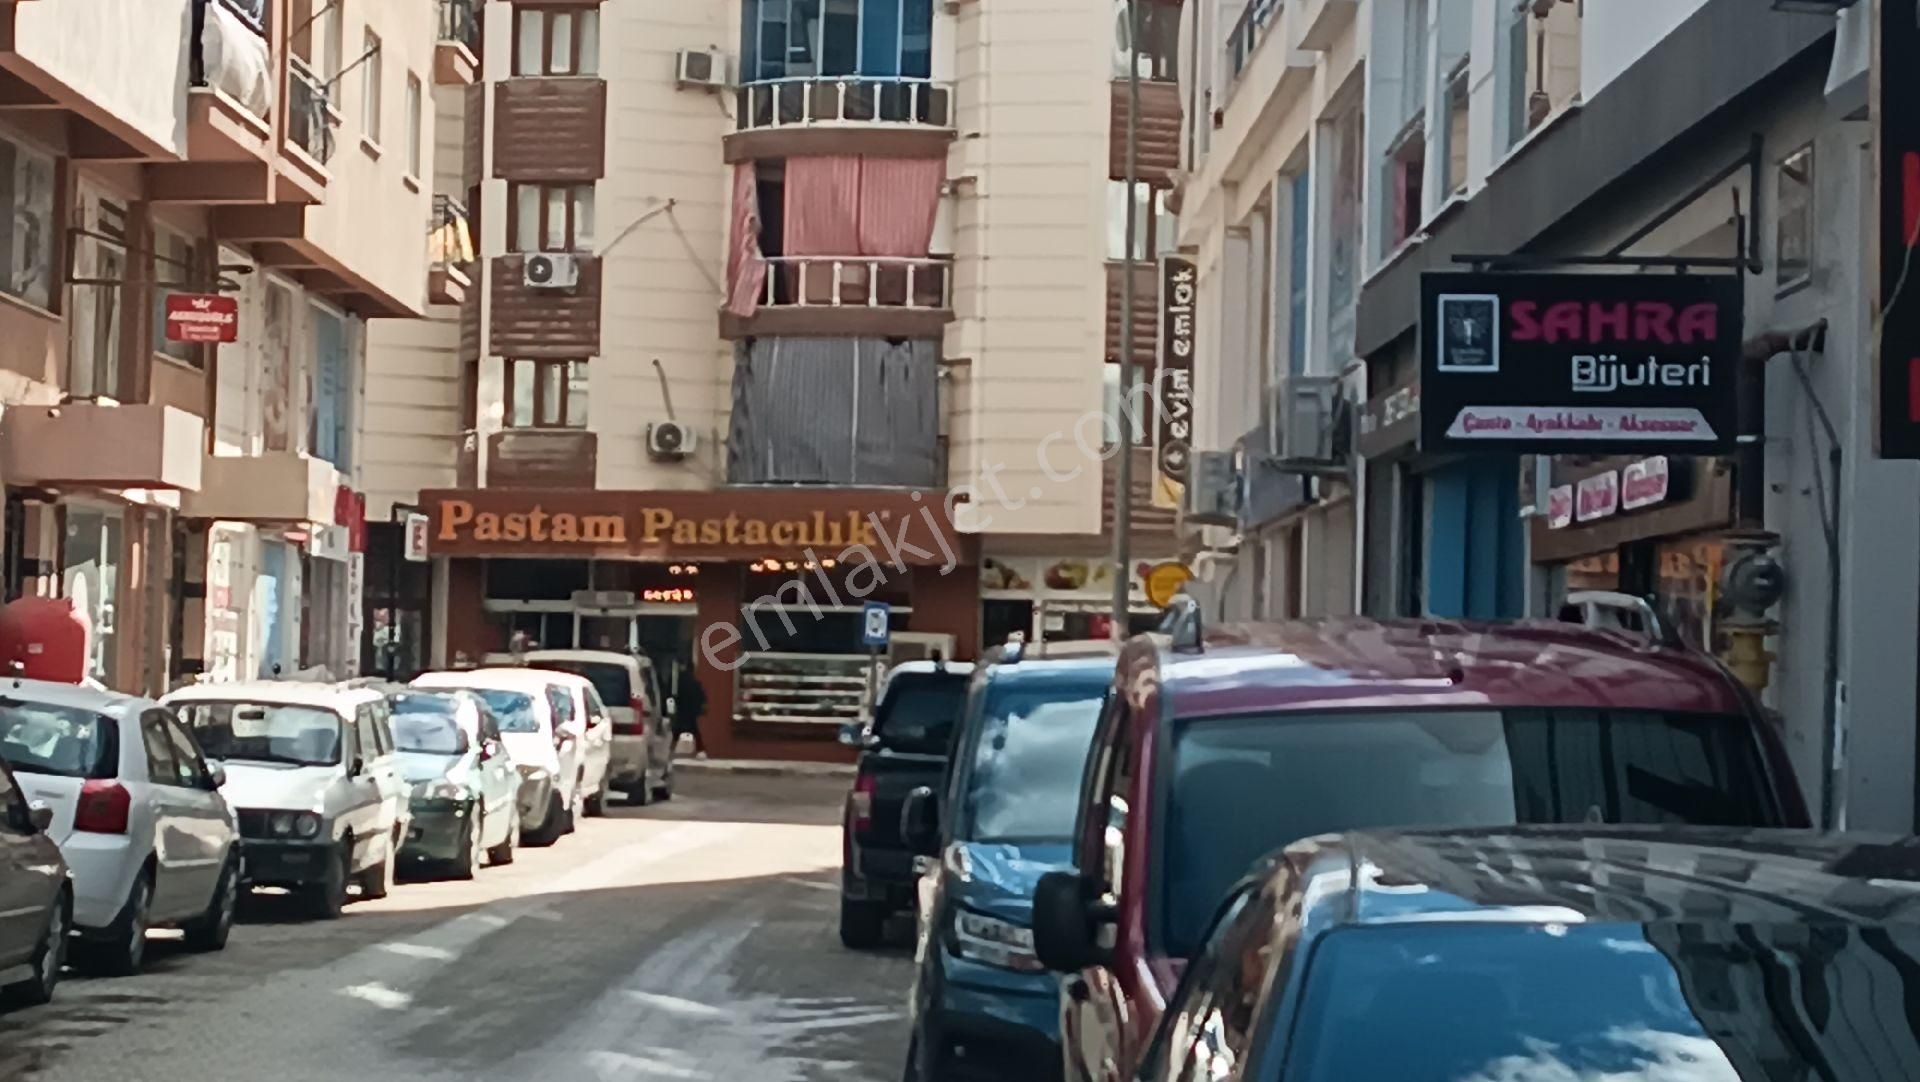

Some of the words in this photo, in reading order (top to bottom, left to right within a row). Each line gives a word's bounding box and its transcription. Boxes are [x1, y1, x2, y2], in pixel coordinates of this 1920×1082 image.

[1510, 301, 1718, 343] SAHRA
[1571, 354, 1710, 392] Bijuteri
[438, 500, 627, 543] Pastam
[641, 507, 876, 546] Pastacılık
